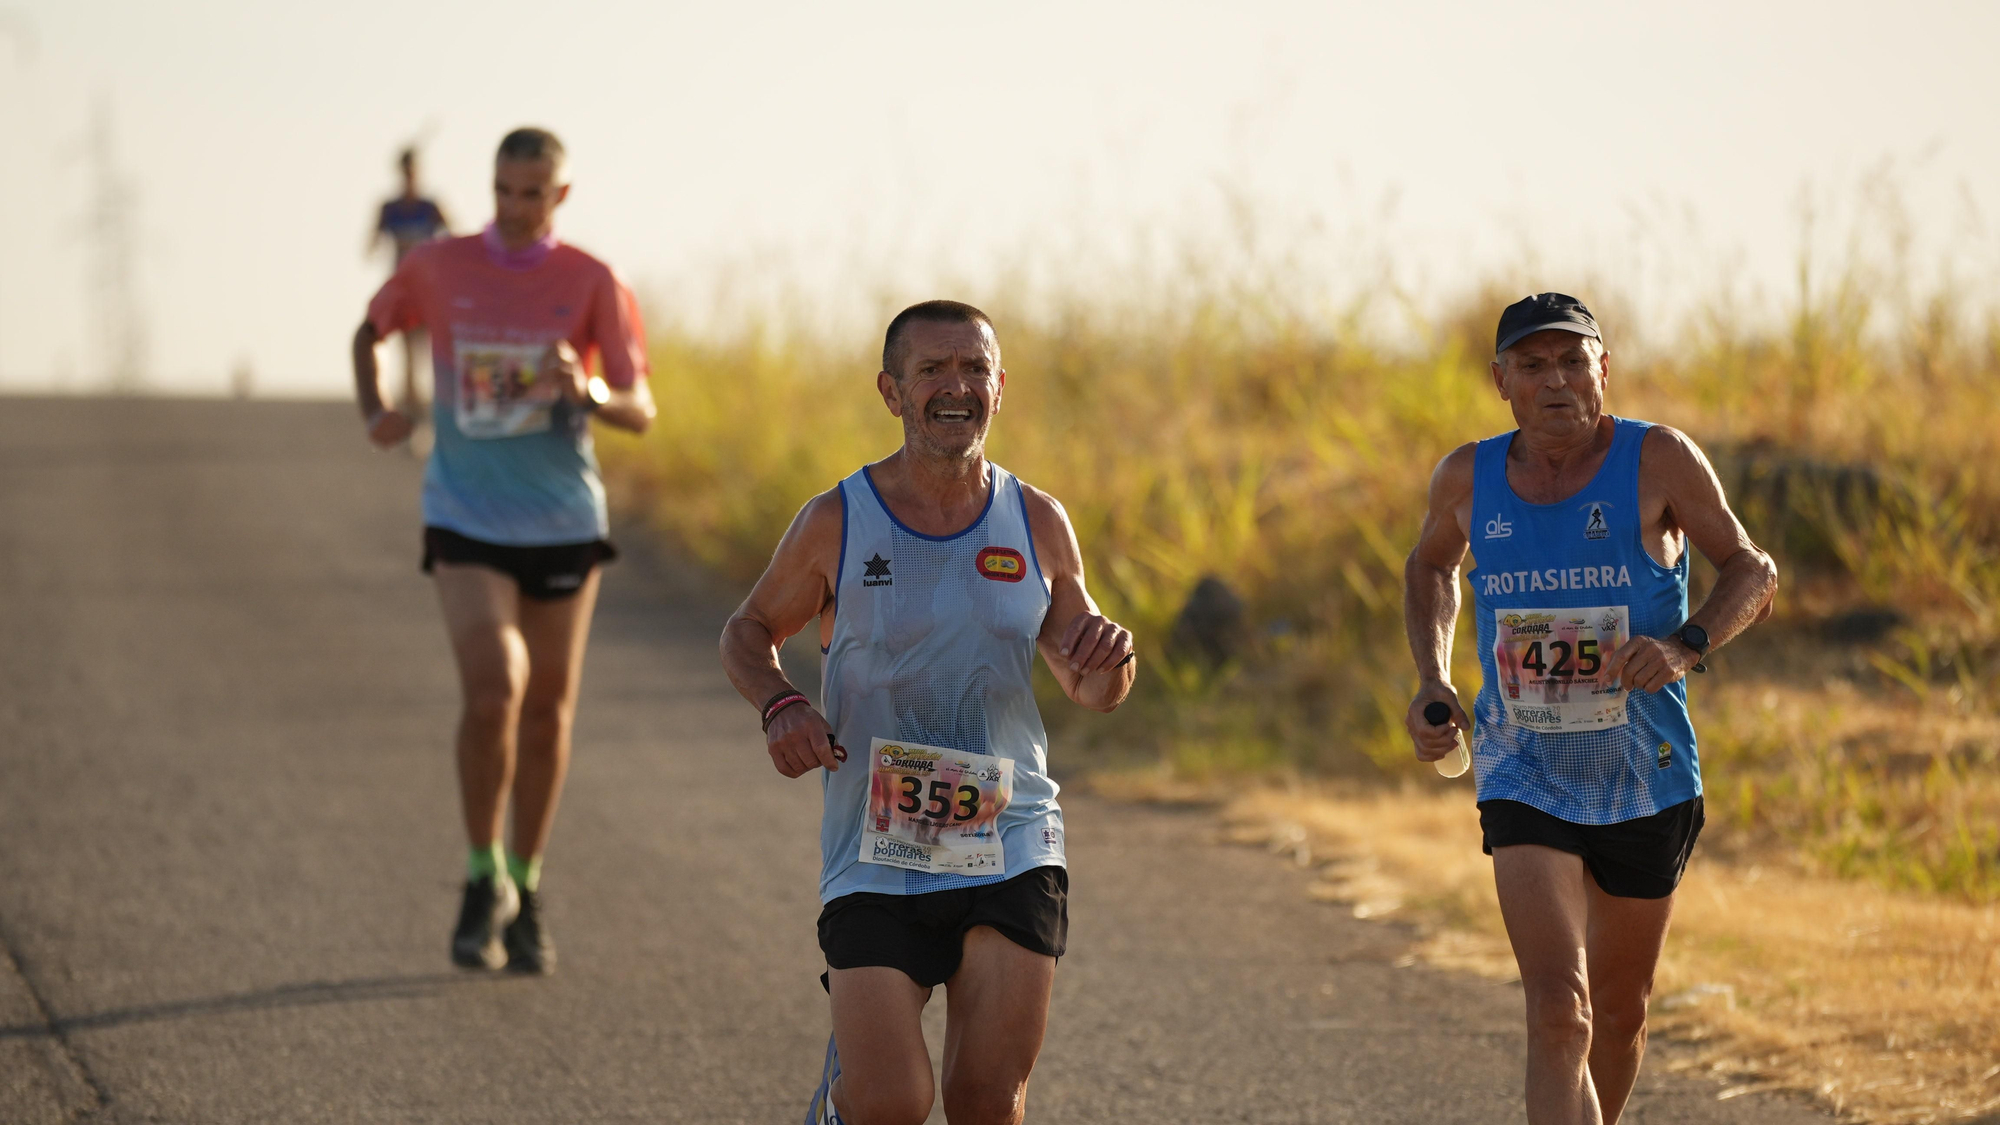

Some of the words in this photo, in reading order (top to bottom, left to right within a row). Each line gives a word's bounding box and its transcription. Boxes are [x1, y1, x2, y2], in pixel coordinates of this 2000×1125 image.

[1484, 513, 1513, 540] als
[863, 578, 893, 587] luanvi
[1522, 640, 1601, 676] 425
[898, 776, 980, 821] 353
[873, 847, 932, 862] populares
[875, 840, 922, 855] rreras
